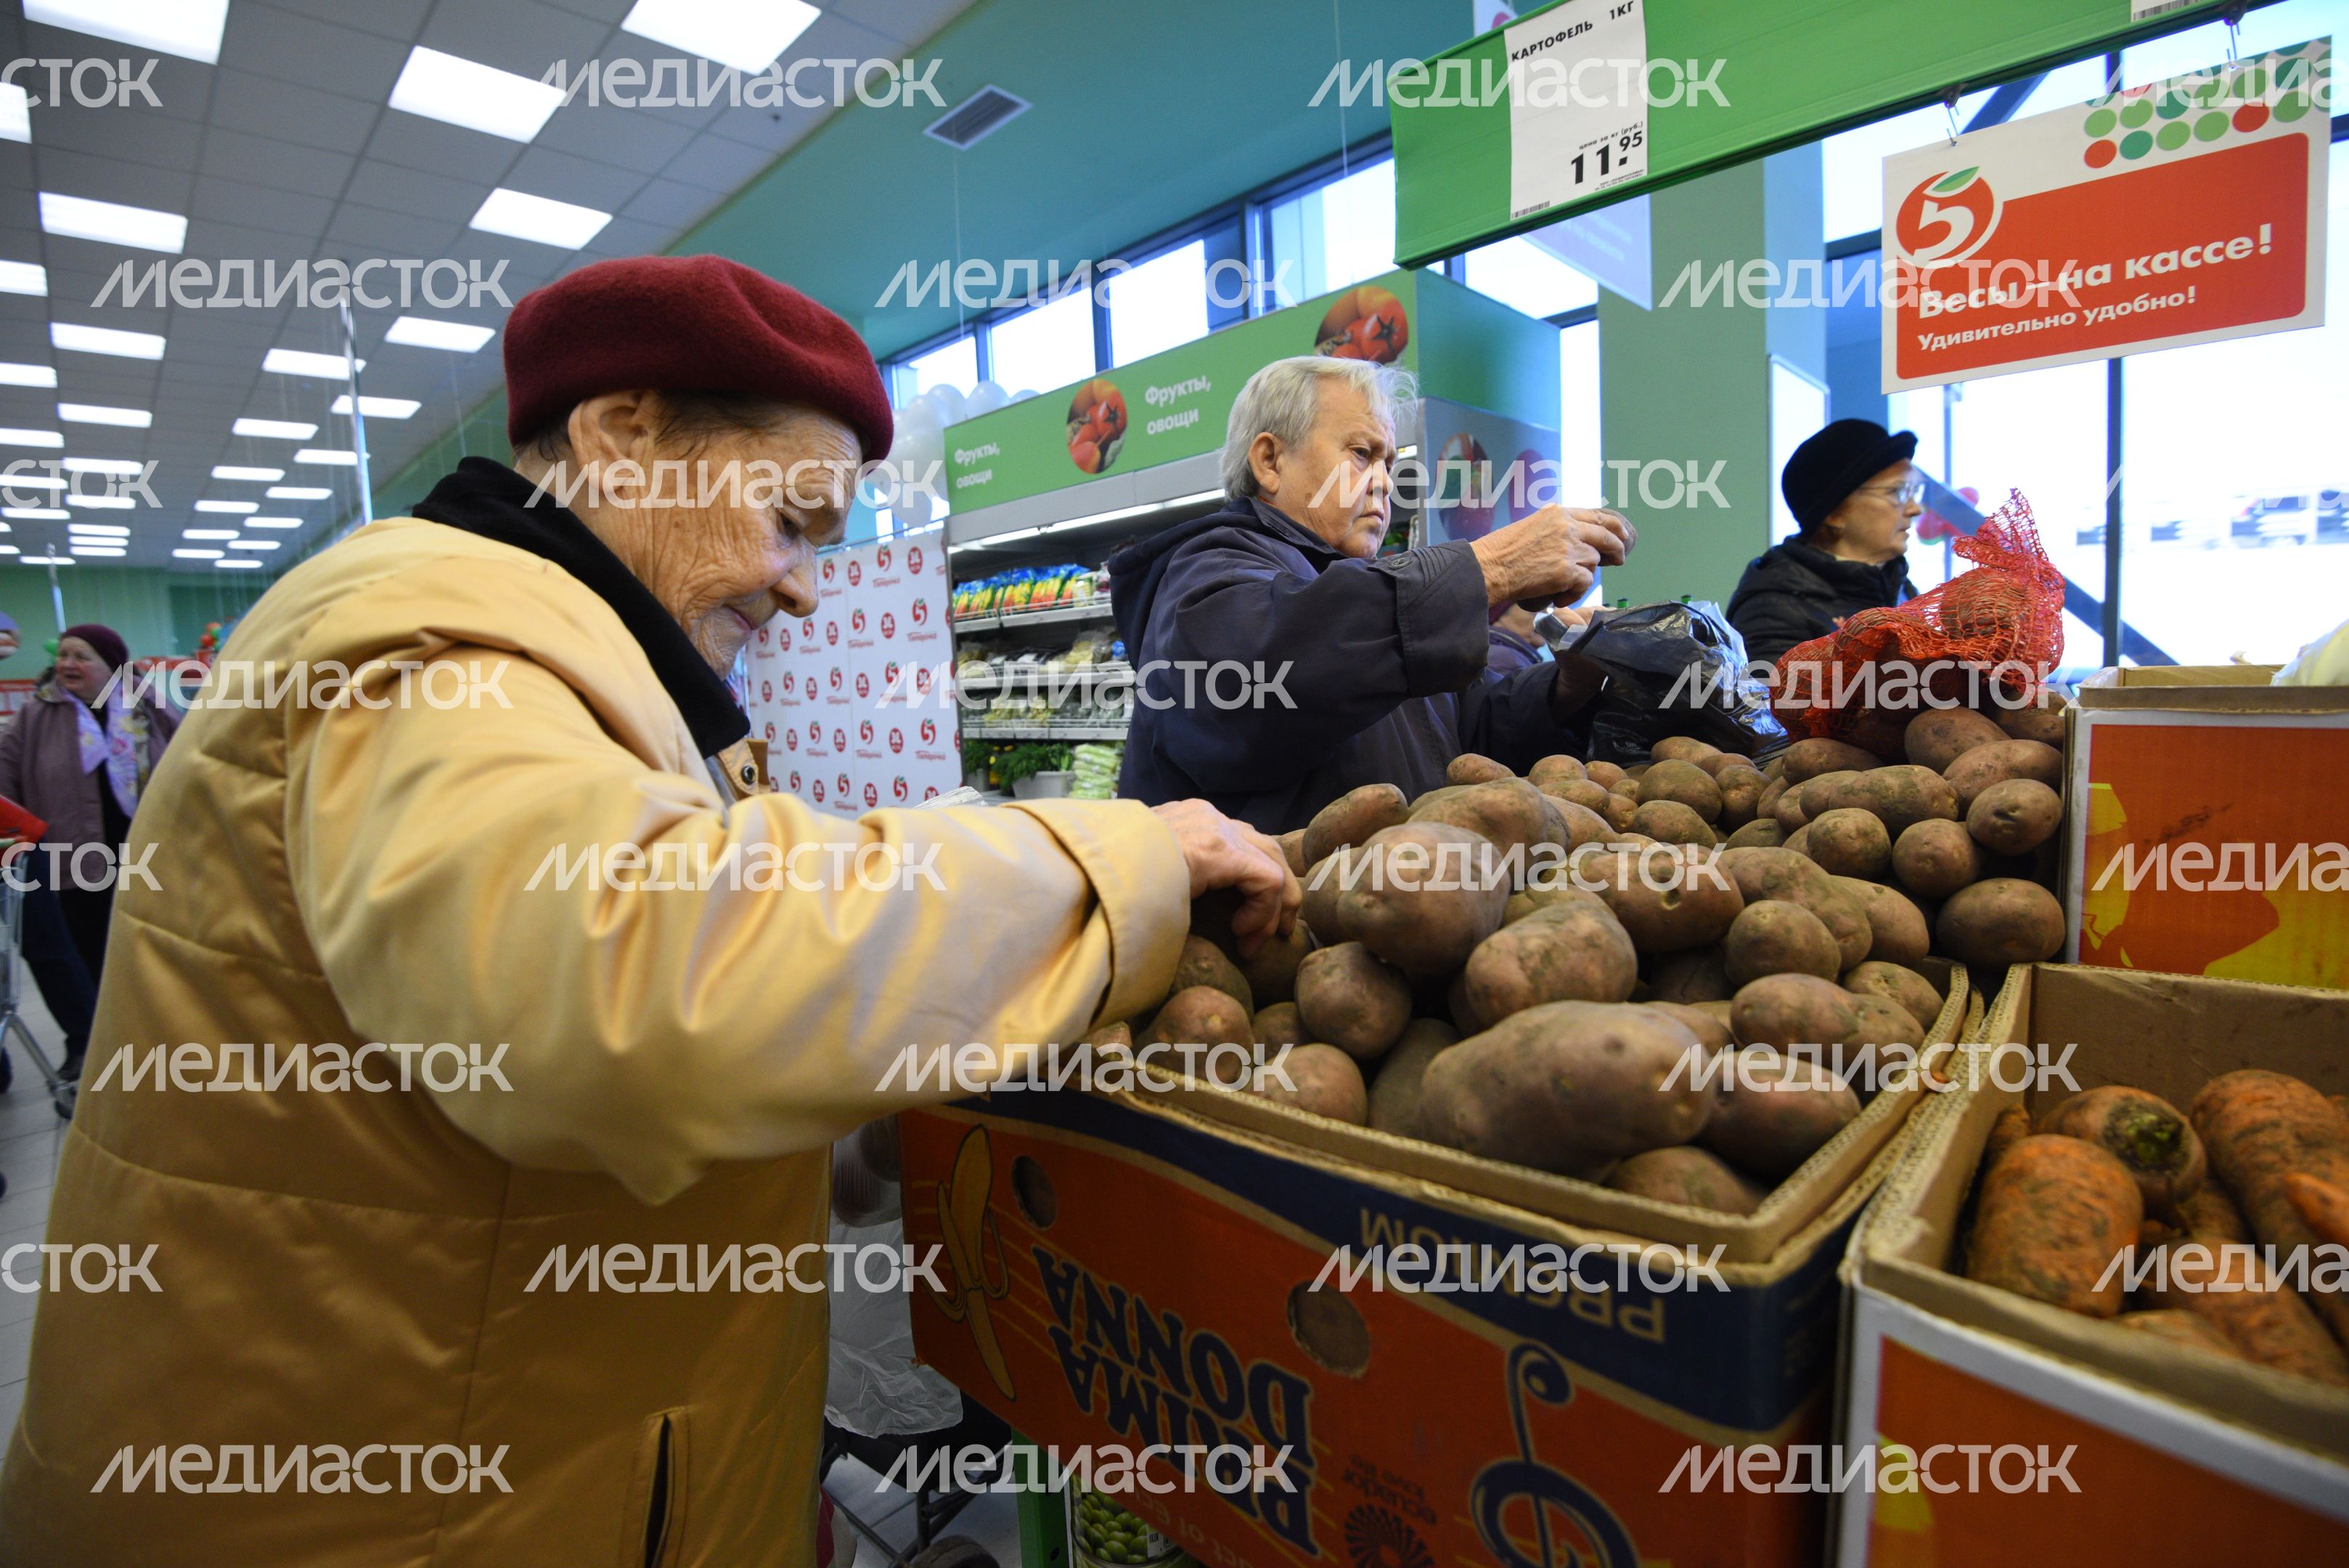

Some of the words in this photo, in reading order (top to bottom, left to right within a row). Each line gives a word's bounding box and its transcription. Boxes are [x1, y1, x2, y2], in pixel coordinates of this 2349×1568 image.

[1511, 20, 1593, 62] КАРТОФЕЛЬ
[1609, 1, 1635, 20] 1КГ
[1919, 283, 2018, 319] Весы
[2059, 264, 2111, 292] на
[2125, 223, 2272, 279] кассе!
[1917, 311, 2077, 351] Удивительно
[2083, 285, 2196, 326] удобно!
[1145, 375, 1212, 407] Фрукты,
[1147, 408, 1199, 436] овощи
[955, 442, 1000, 467] Фрукты,
[956, 469, 992, 489] овощи
[1031, 1246, 1316, 1469] DONNA
[1047, 1326, 1321, 1557] PRIMA
